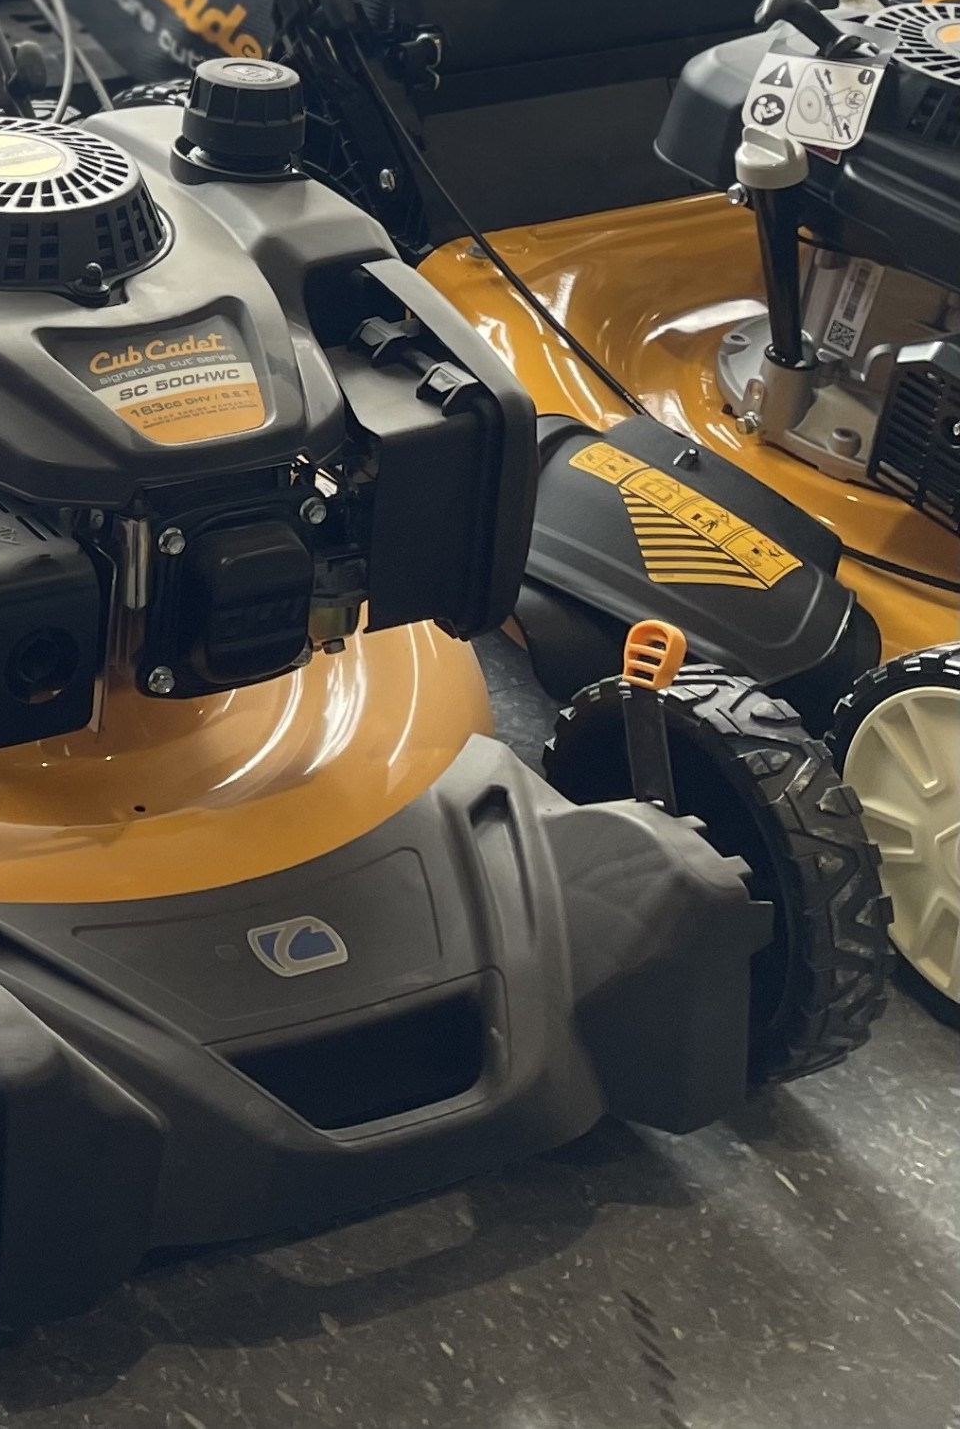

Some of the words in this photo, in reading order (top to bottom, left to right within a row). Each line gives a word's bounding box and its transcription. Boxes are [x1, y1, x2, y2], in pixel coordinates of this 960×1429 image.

[89, 345, 143, 374] Cub
[145, 333, 226, 361] Cadet
[100, 362, 166, 385] signature
[169, 357, 192, 368] cut
[196, 353, 237, 364] series
[119, 384, 149, 401] SC
[155, 369, 241, 391] 500HWC
